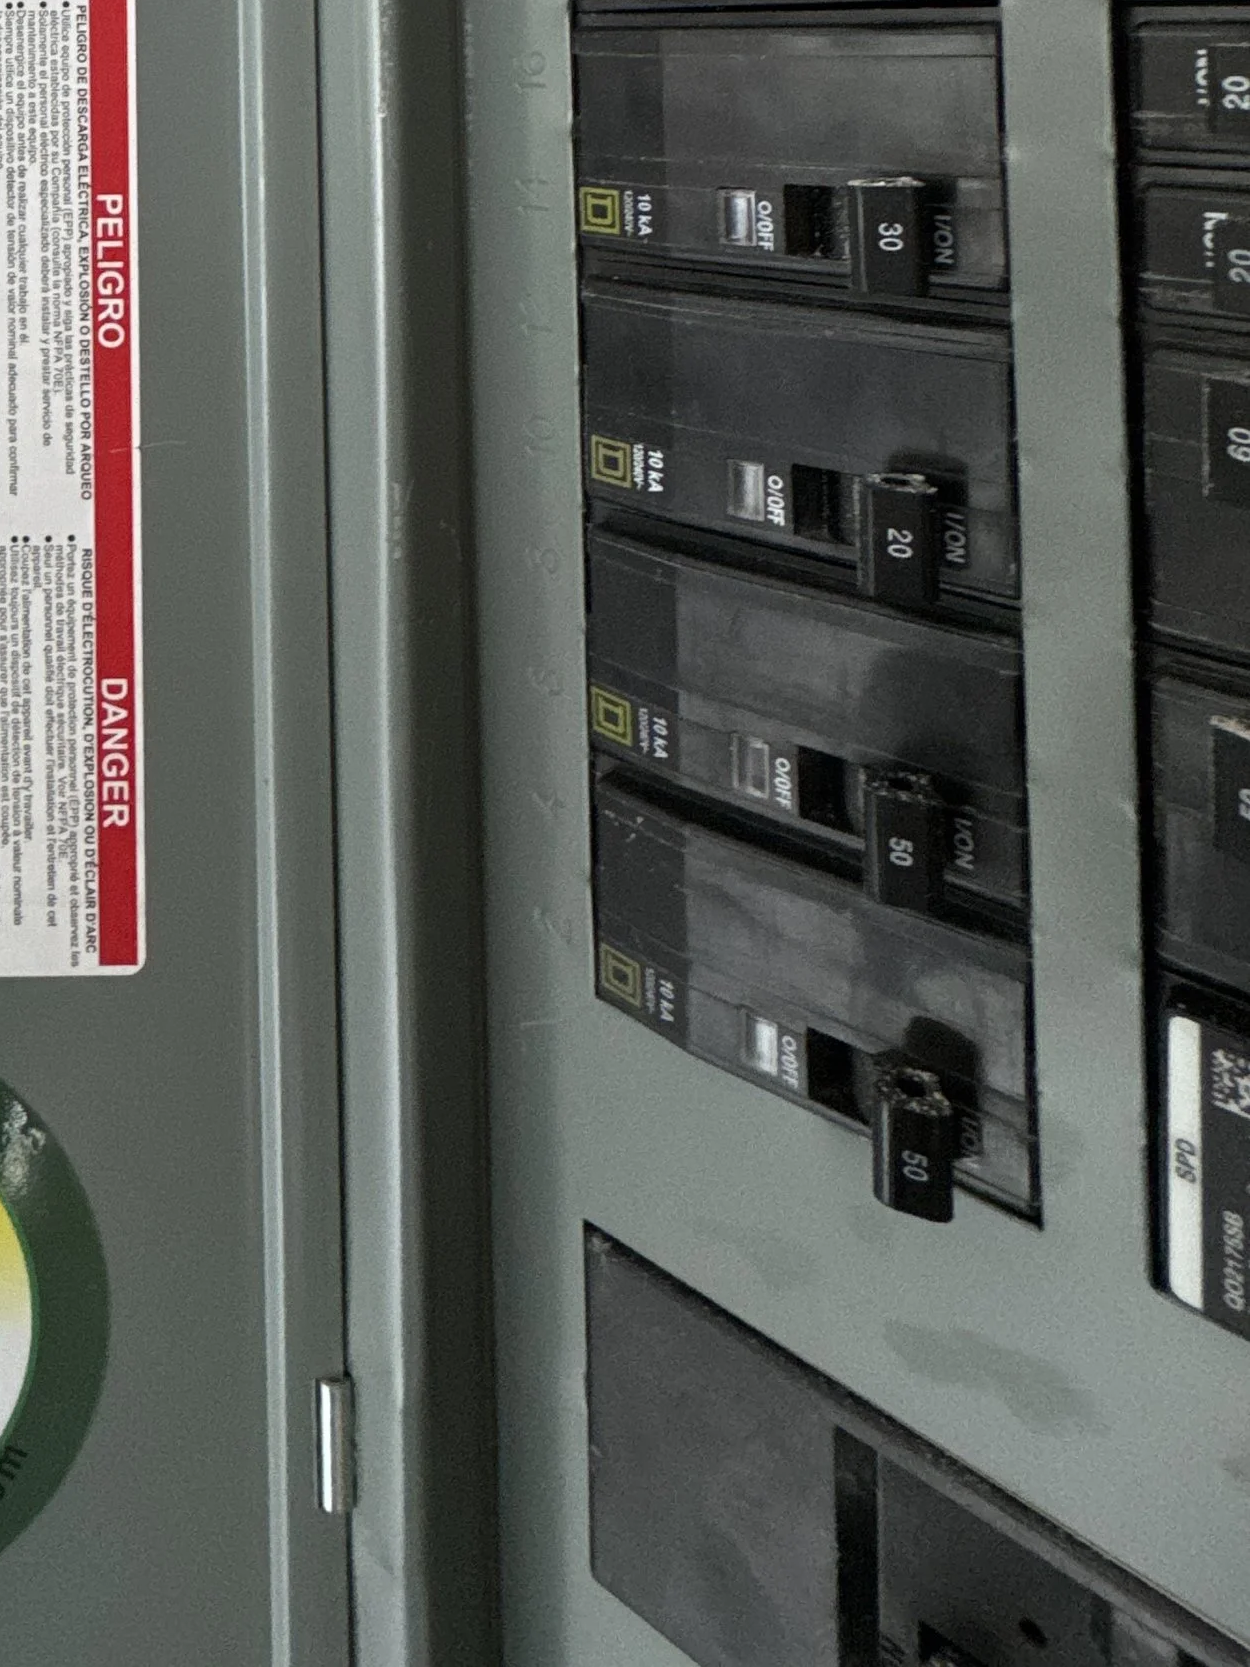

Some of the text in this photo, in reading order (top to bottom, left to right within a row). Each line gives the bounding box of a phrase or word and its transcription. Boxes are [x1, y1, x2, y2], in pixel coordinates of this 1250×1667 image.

[879, 223, 903, 250] 30
[97, 195, 124, 347] PELIGRO
[888, 529, 912, 558] 20
[102, 679, 129, 827] DANGER
[890, 838, 913, 866] 50
[902, 1151, 928, 1181] 50
